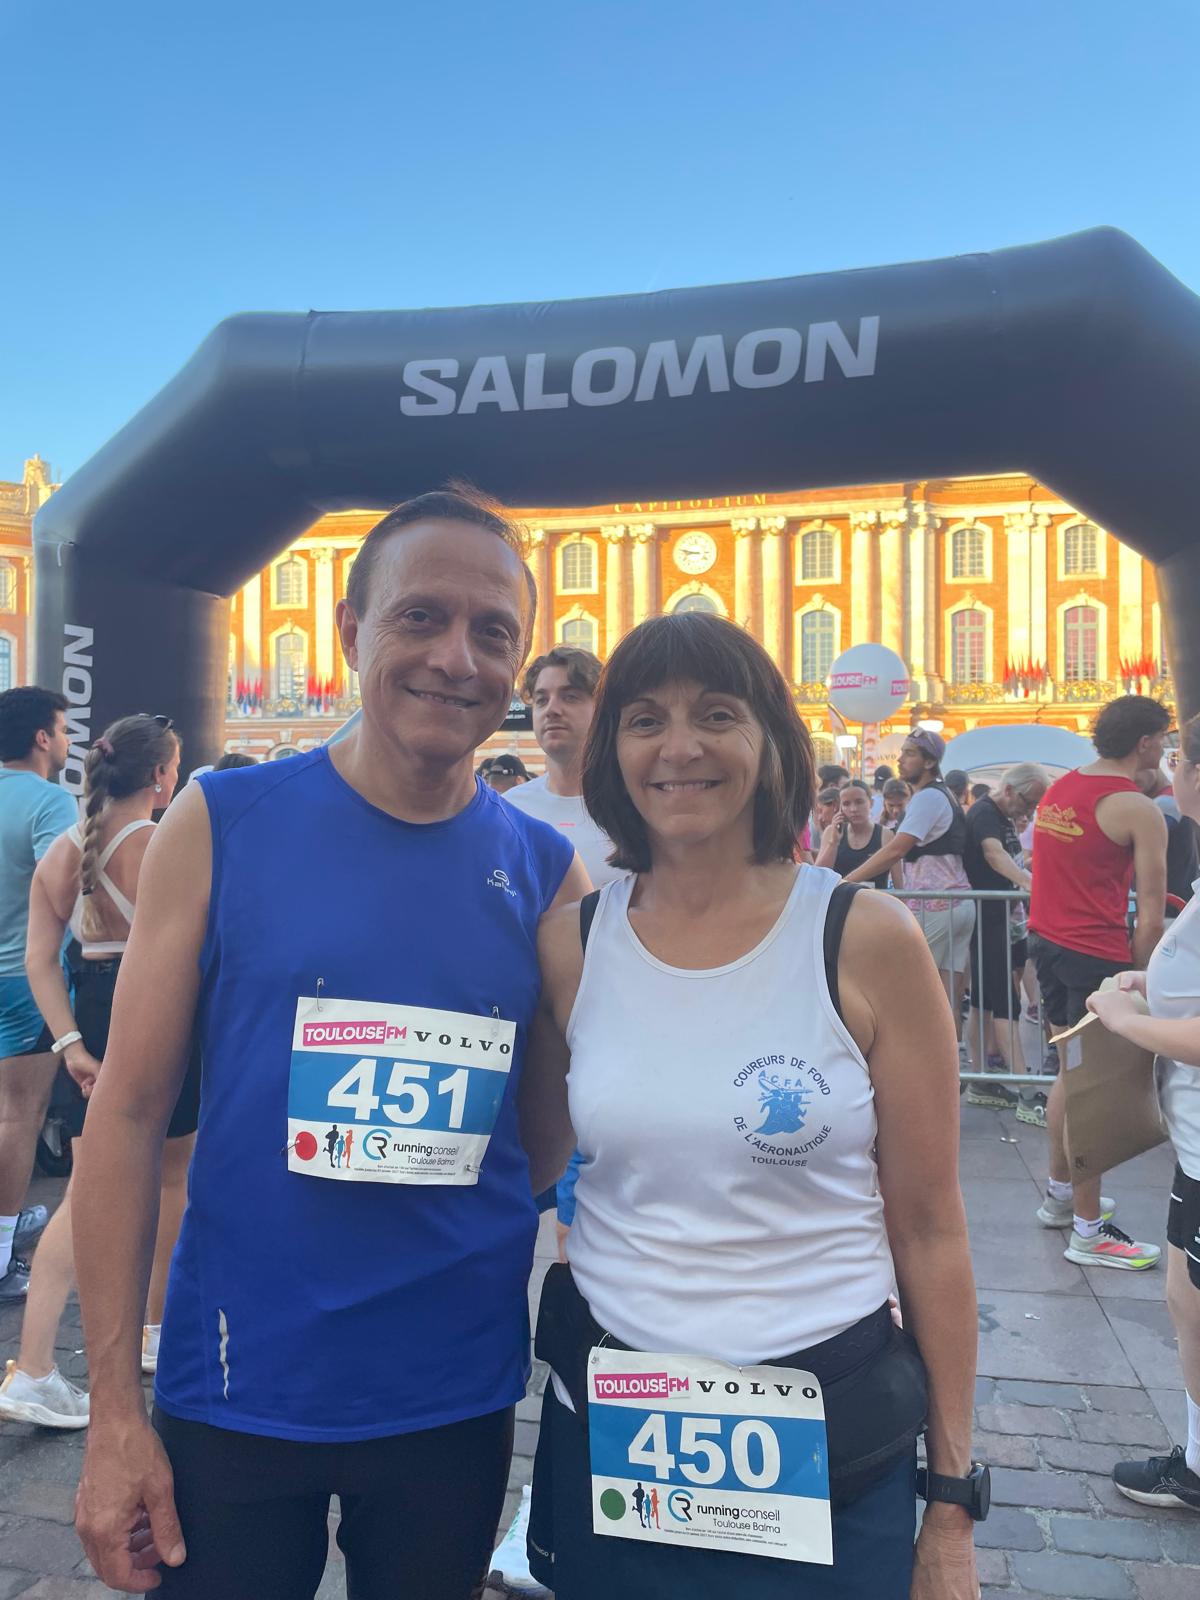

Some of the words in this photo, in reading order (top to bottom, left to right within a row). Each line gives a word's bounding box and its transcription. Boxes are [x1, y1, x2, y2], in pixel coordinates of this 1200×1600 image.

[400, 316, 880, 417] SALOMON
[59, 624, 94, 800] OMON
[304, 1025, 385, 1042] TOULOUSE
[386, 1025, 408, 1040] FM
[414, 1030, 511, 1055] VOLVO
[733, 1055, 785, 1088] COUREURS
[790, 1057, 806, 1070] DE
[807, 1067, 831, 1096] FOND
[327, 1058, 470, 1129] 451
[733, 1116, 748, 1132] DE
[744, 1124, 832, 1156] L'AERONAUTIQUE
[407, 1155, 437, 1166] Toulouse
[751, 1156, 808, 1167] TOULOUSE
[596, 1377, 667, 1394] TOULOUSE
[669, 1376, 690, 1392] FM
[697, 1380, 818, 1399] VOLVO
[628, 1413, 781, 1489] 450
[713, 1518, 751, 1531] Toulouse
[752, 1521, 781, 1534] Balma
